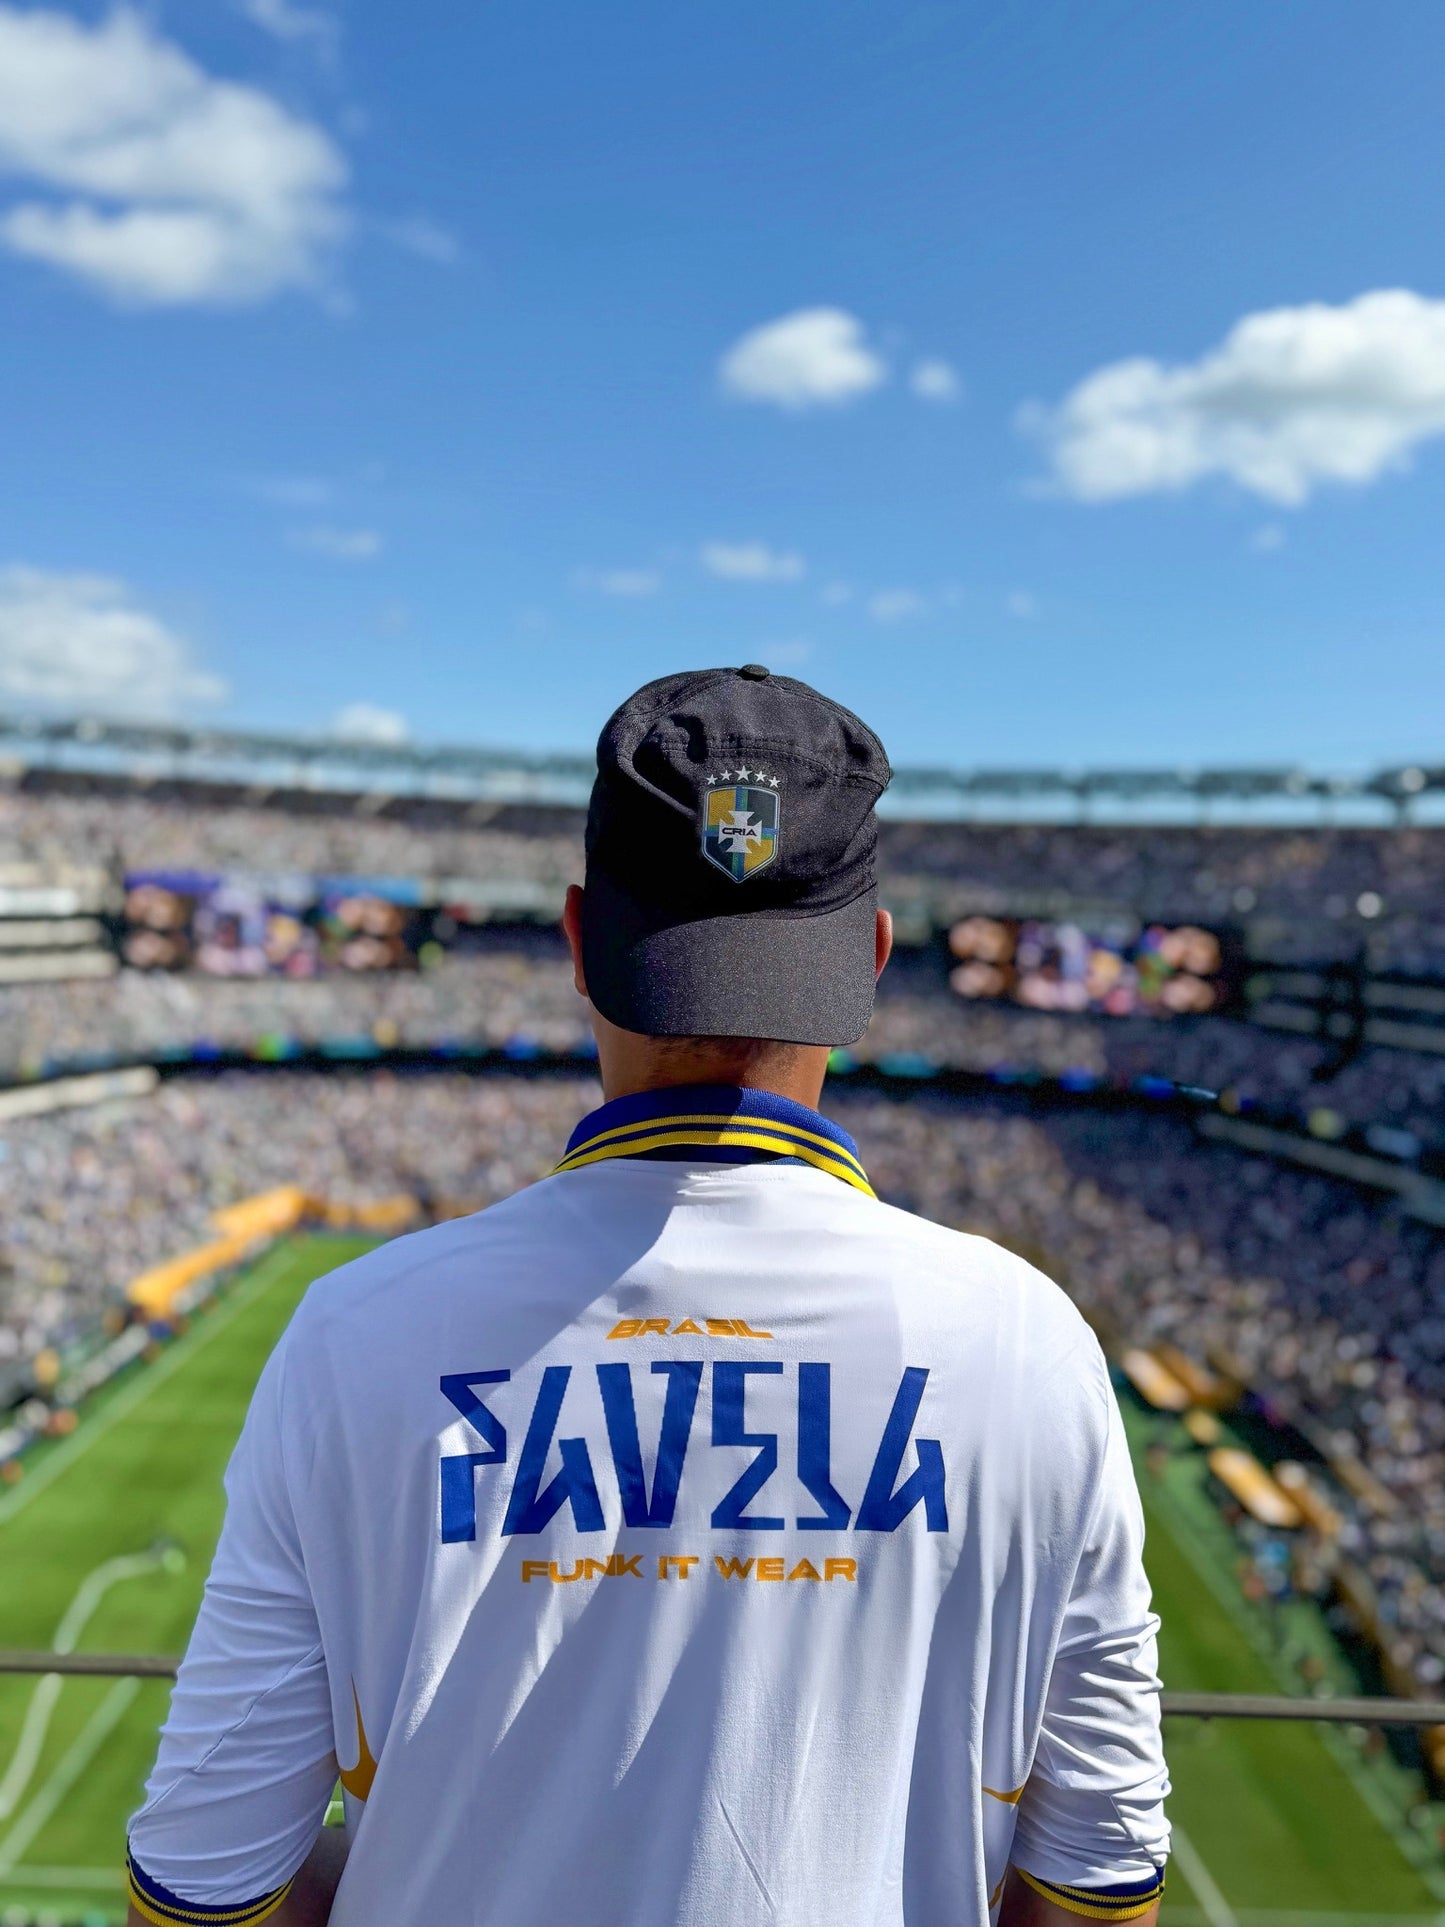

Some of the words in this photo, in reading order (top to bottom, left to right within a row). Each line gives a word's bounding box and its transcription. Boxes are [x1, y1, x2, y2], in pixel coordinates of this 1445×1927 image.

[722, 827, 757, 837] CRIA
[606, 1318, 774, 1340] BRASIL
[521, 1554, 644, 1583] FUNK
[657, 1555, 699, 1580] IT
[714, 1555, 857, 1582] WEAR
